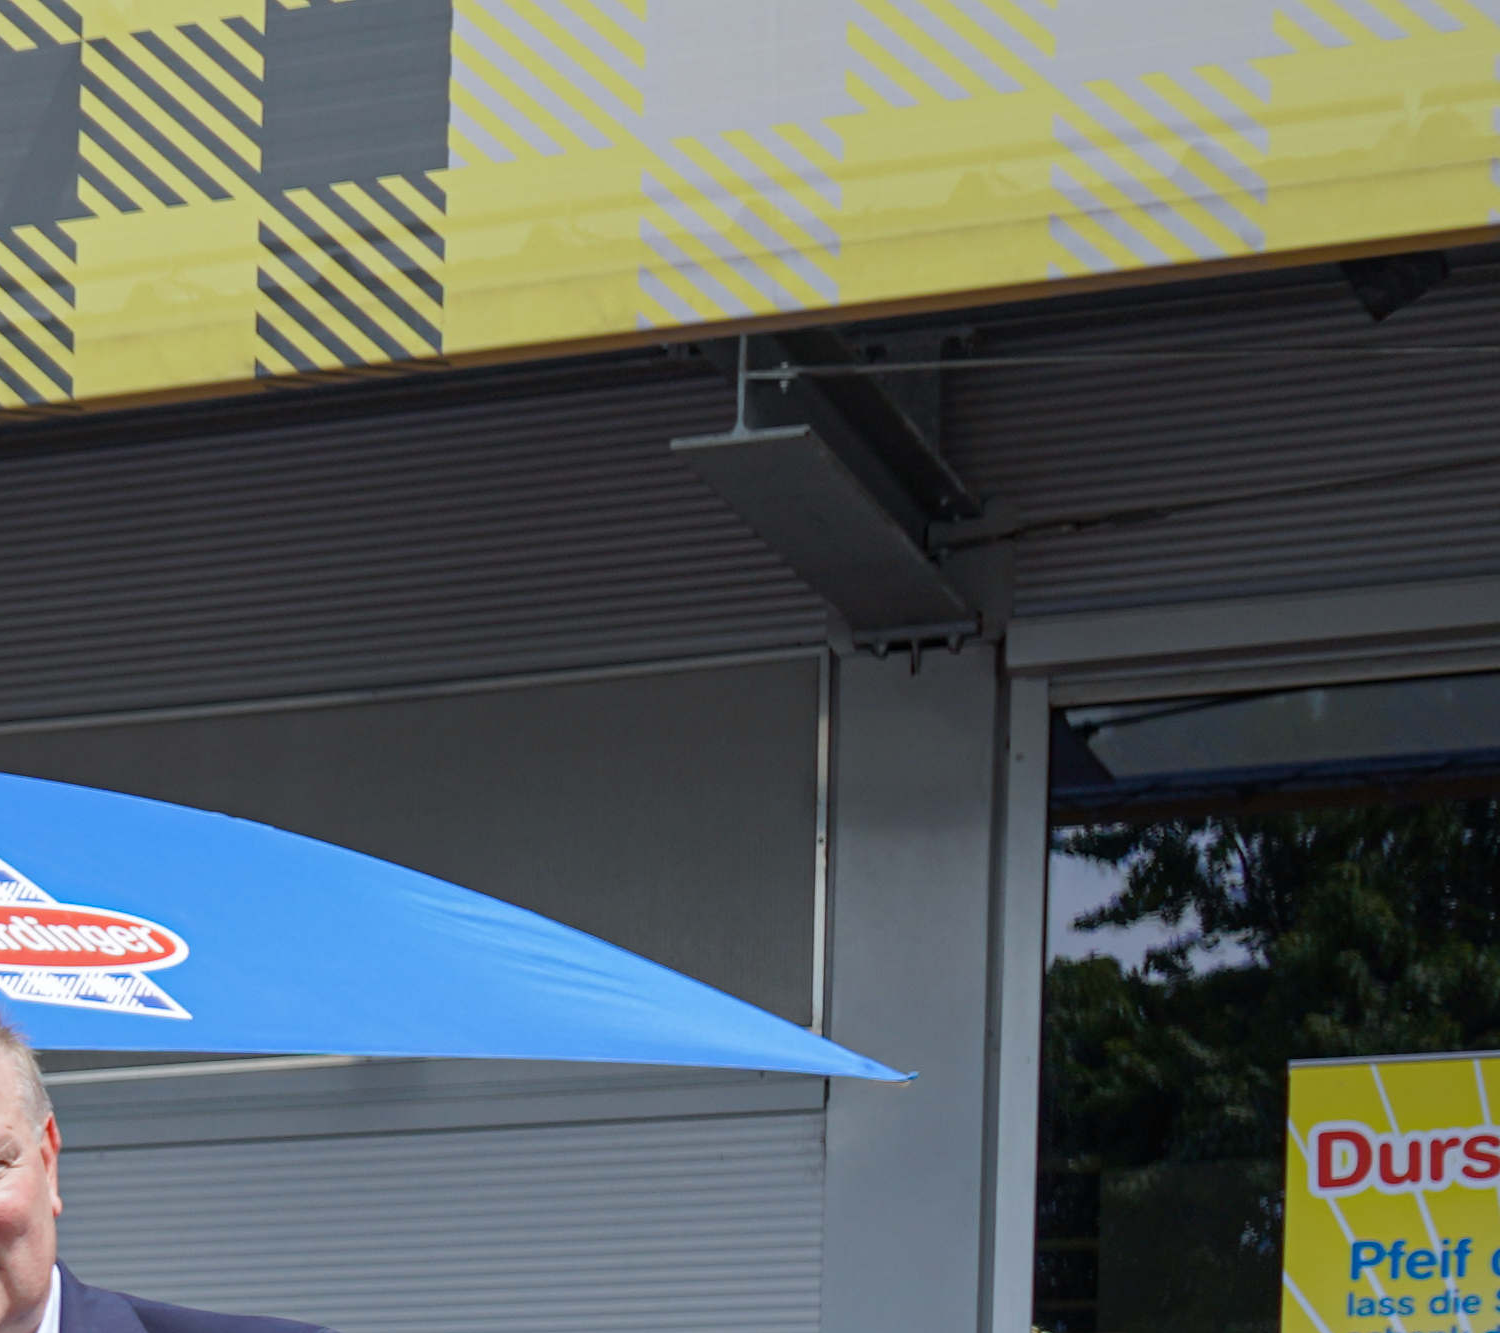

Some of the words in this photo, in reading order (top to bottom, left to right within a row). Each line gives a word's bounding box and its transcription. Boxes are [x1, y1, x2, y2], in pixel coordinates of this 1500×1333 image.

[1350, 1238, 1474, 1281] Pfeif
[1346, 1292, 1416, 1317] lass
[1428, 1288, 1482, 1315] die
